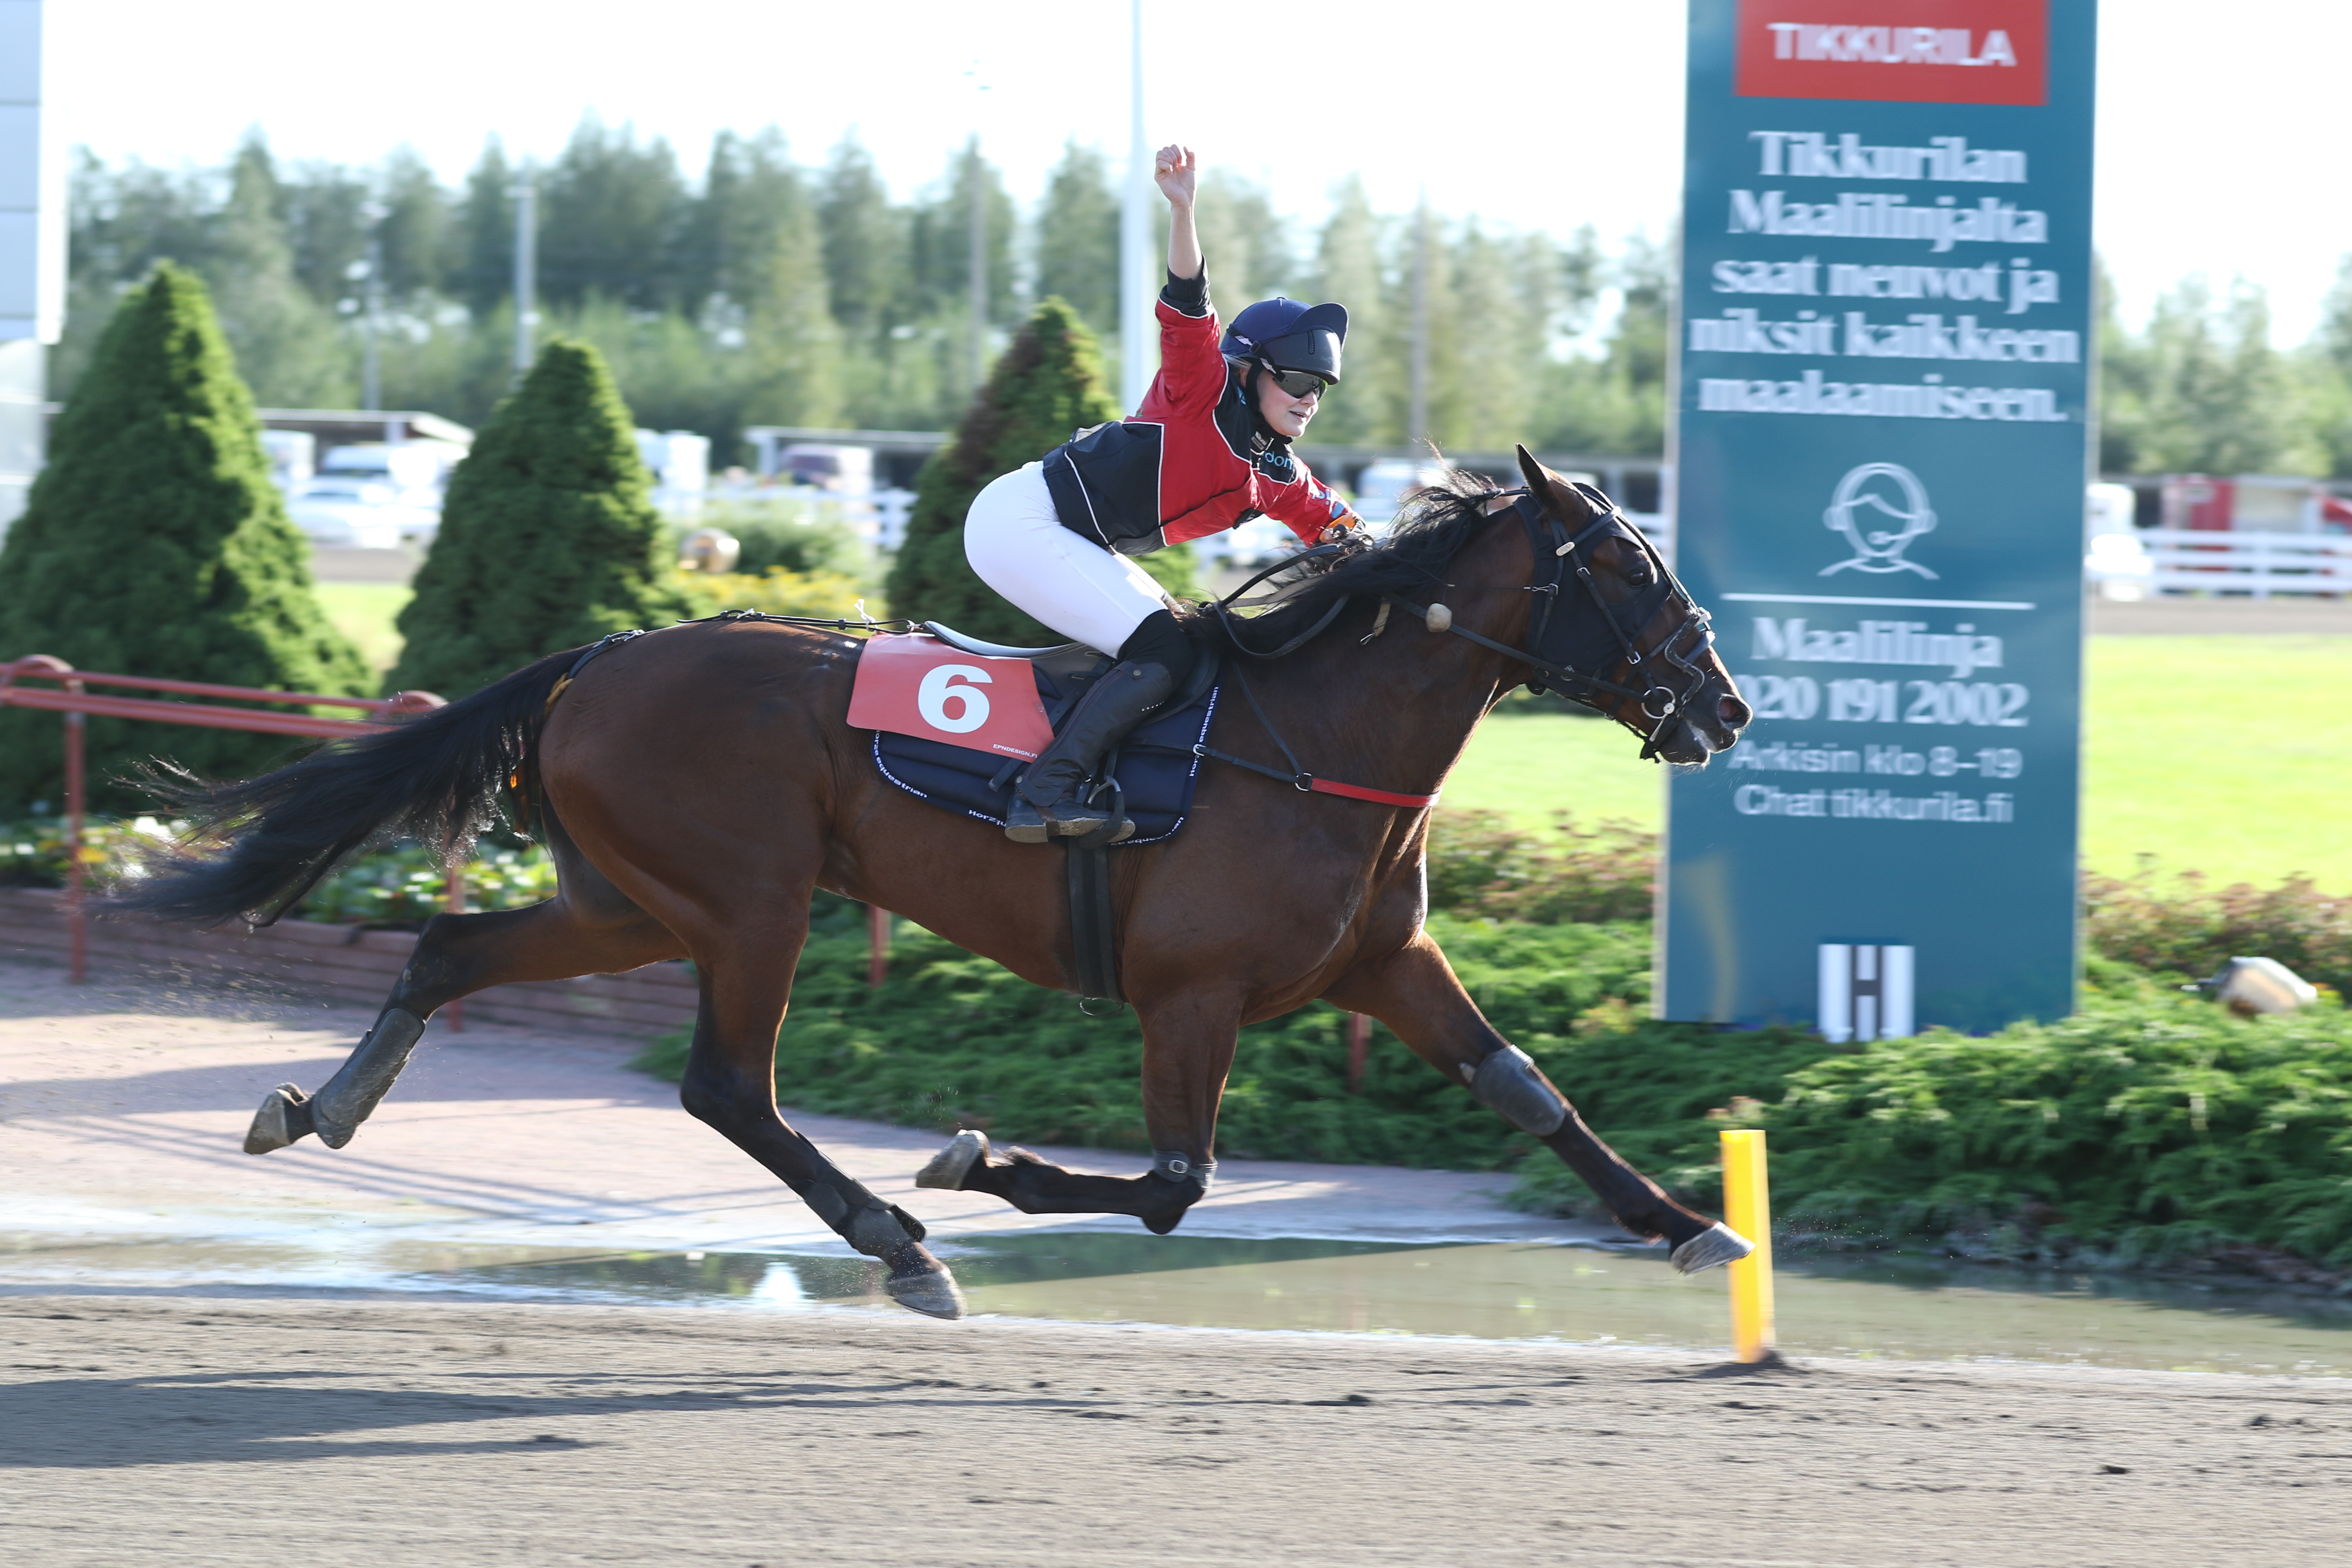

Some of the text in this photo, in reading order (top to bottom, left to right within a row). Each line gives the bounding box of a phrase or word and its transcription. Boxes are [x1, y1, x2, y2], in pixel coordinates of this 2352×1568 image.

[1766, 22, 2017, 67] TIKKURILA
[1748, 131, 2027, 183] Tikkurilan
[1727, 189, 2049, 253] Maalilinjalta
[1711, 255, 2060, 314] saat neuvot ja
[1689, 308, 2081, 363] niksit kaikkeen
[1697, 370, 2069, 422] maalaamiseen.
[1750, 617, 2004, 678] Maalilinja
[917, 664, 993, 733] 6
[1824, 678, 1900, 723] 191
[1902, 680, 2030, 727] 2002
[993, 744, 1038, 759] EPNDESIGN.FI
[1725, 739, 1861, 773] Arkisin
[1864, 744, 1926, 776] klo
[1734, 783, 2014, 823] Chat tikkurila.fi
